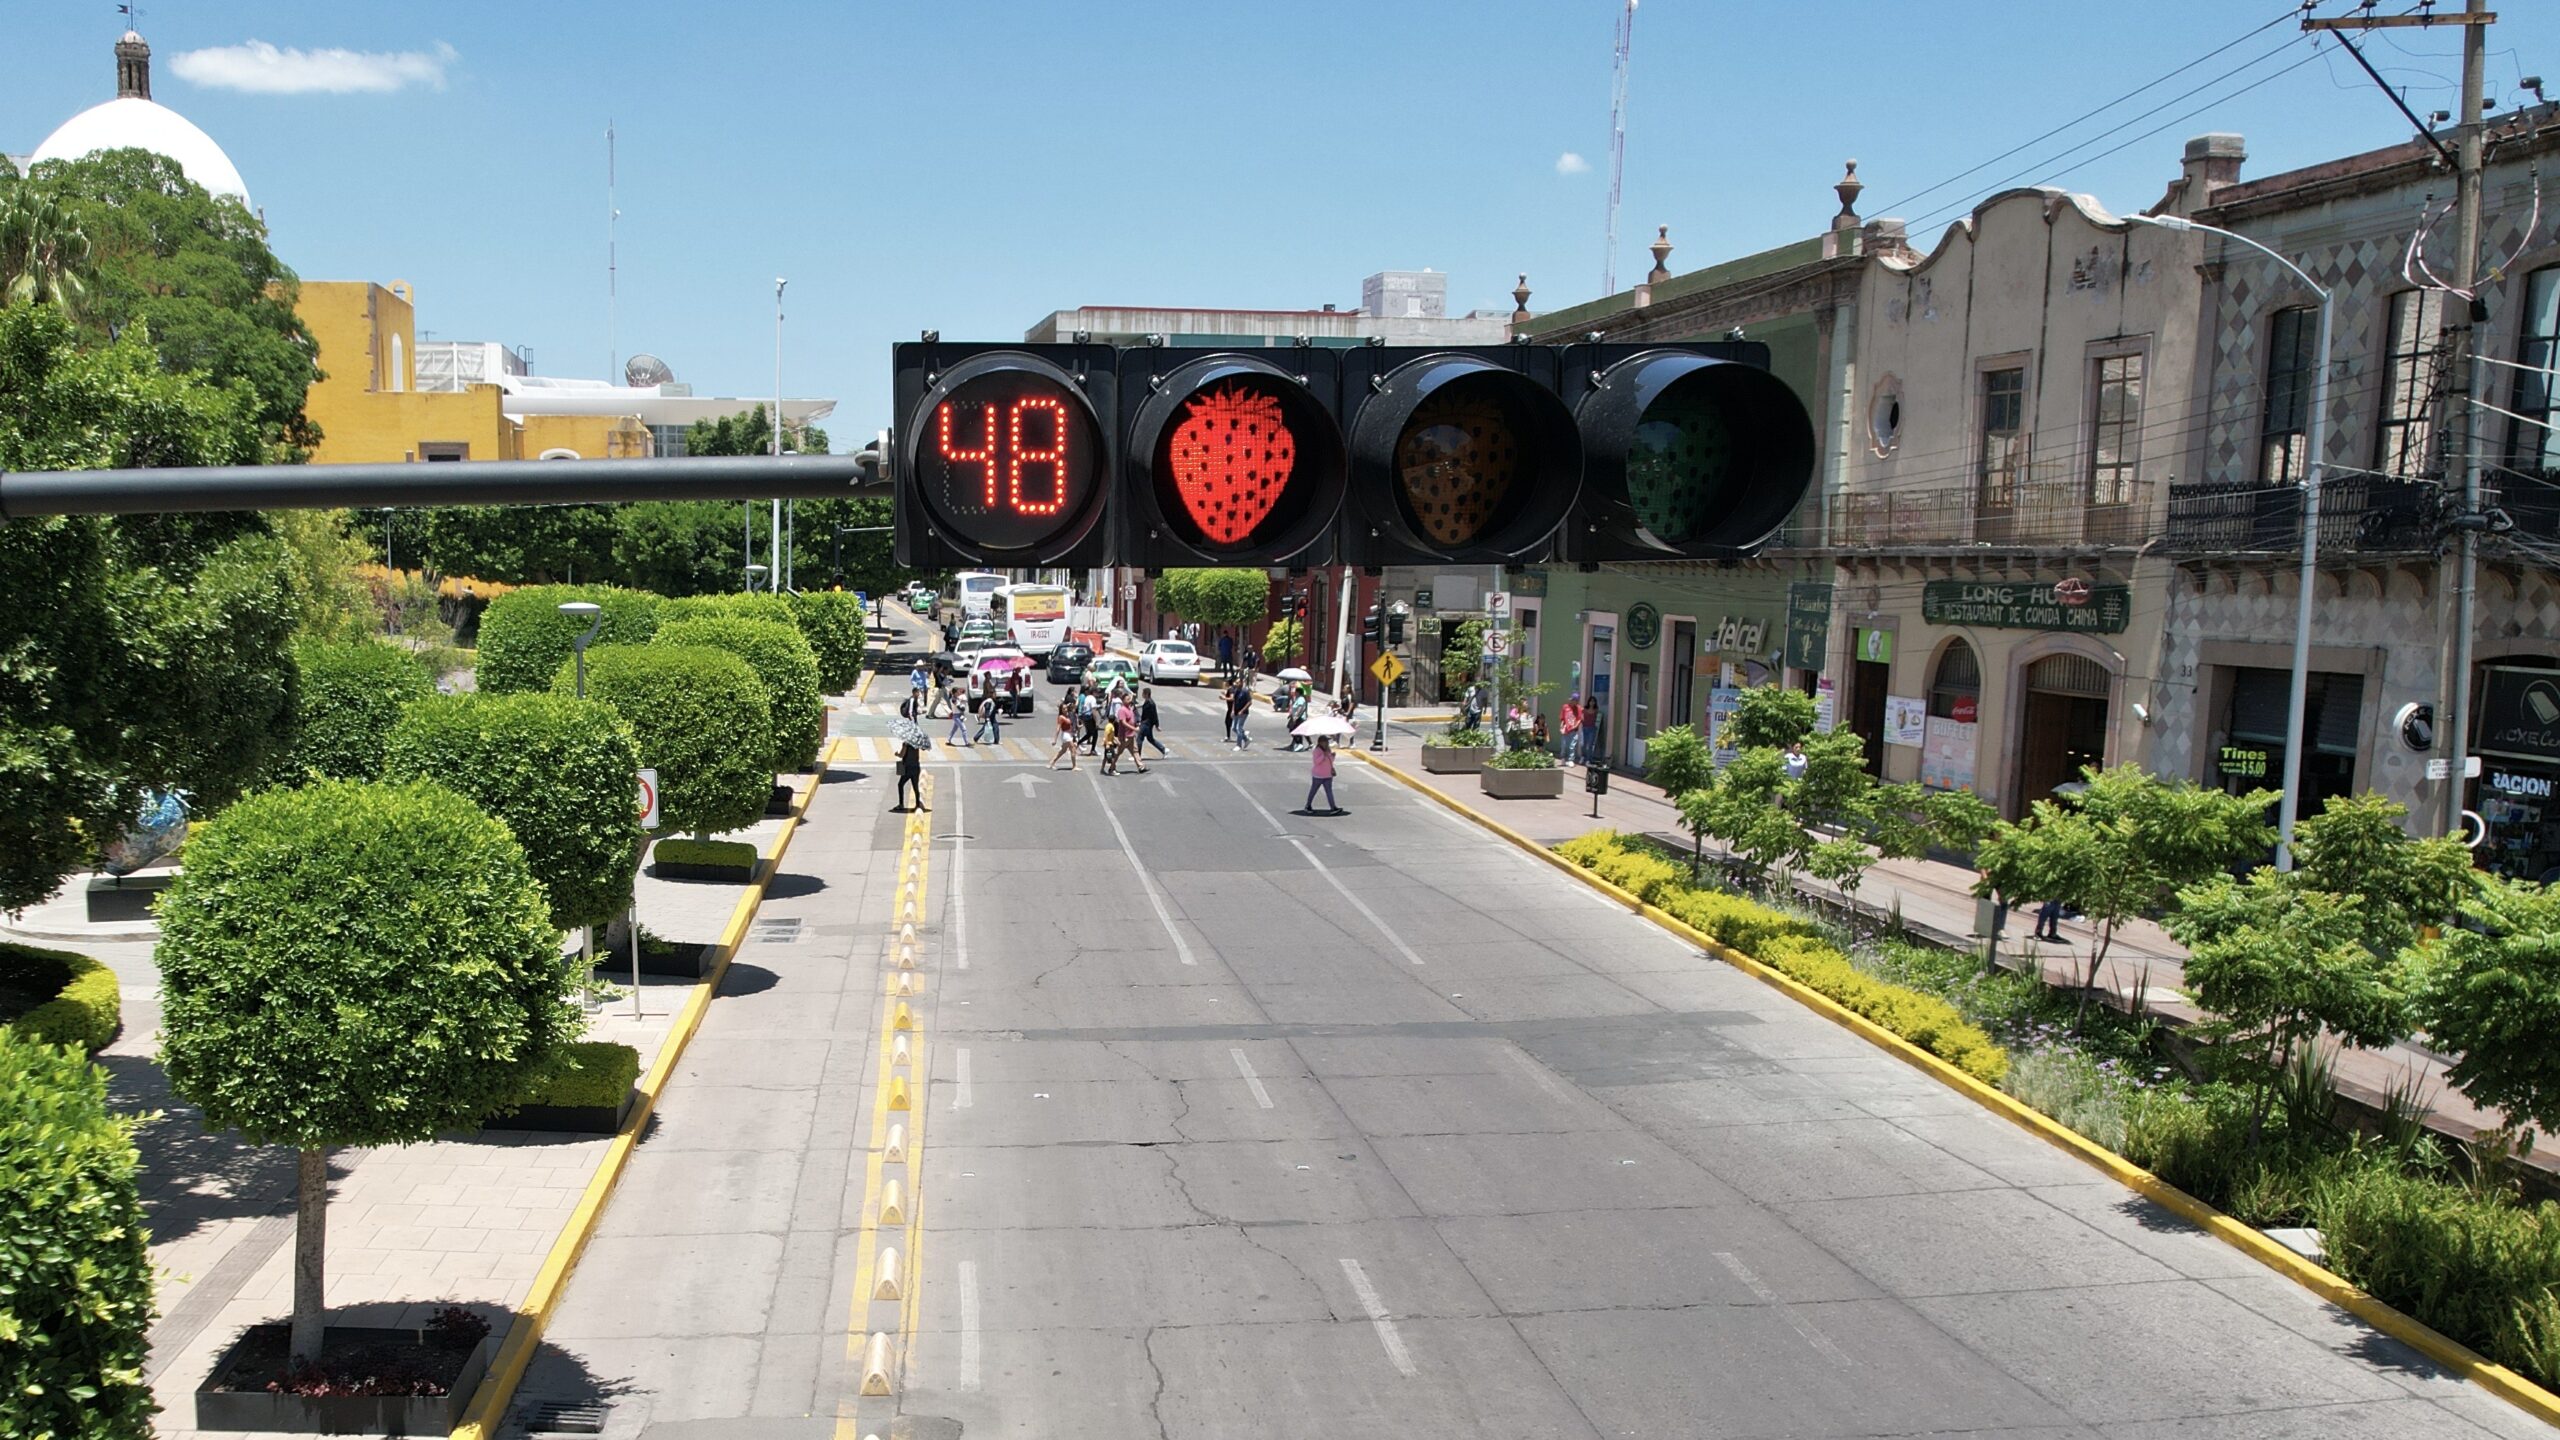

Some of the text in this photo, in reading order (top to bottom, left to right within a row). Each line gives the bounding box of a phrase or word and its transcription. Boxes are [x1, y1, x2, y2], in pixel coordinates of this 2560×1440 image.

[940, 398, 1067, 513] 48
[1961, 585, 2015, 604] LONG
[1944, 604, 2098, 626] RESTAURANT DE COMIDA CHINA
[1716, 616, 1766, 654] telcel
[2181, 665, 2193, 677] 33
[1933, 721, 1974, 741] BUFFET
[2221, 747, 2267, 760] Tines
